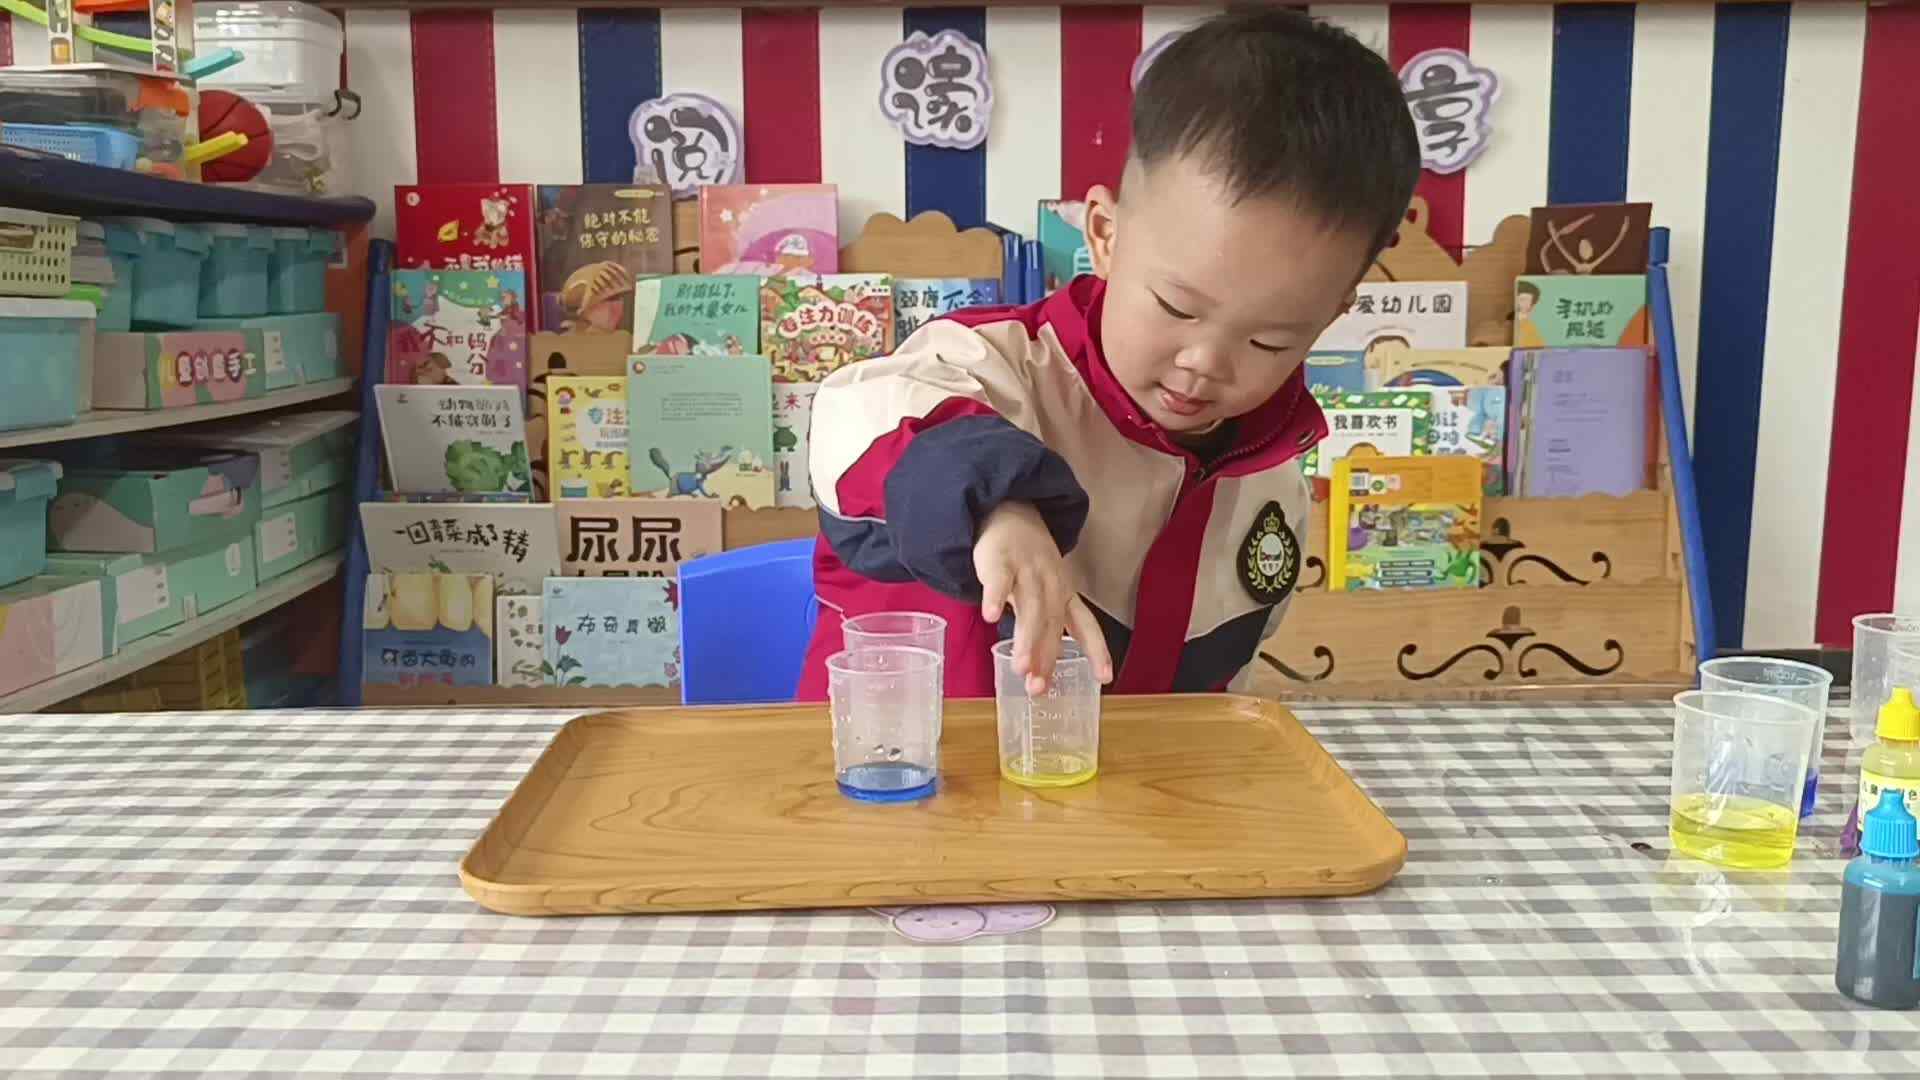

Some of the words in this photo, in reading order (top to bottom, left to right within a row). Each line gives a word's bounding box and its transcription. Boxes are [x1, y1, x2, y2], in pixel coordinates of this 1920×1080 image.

[893, 45, 977, 133] 课
[644, 106, 729, 184] 说
[584, 208, 650, 229] 绝对不能
[566, 516, 682, 563] 尿尿
